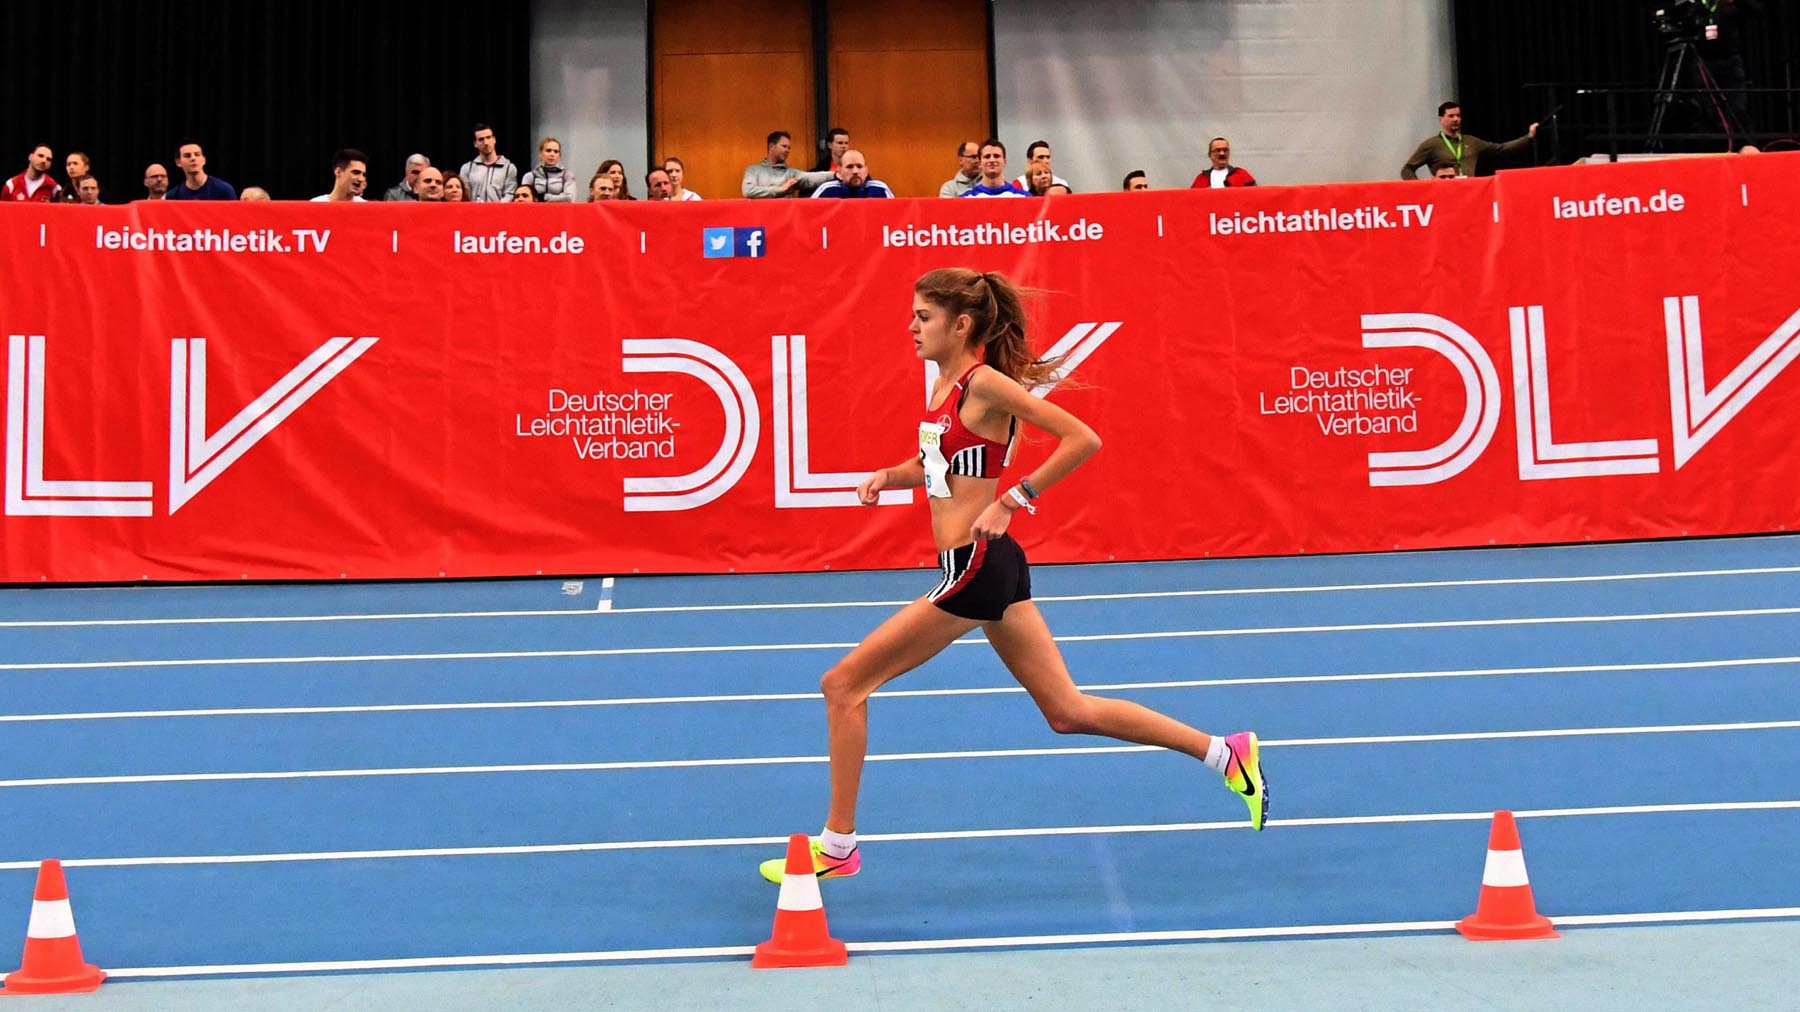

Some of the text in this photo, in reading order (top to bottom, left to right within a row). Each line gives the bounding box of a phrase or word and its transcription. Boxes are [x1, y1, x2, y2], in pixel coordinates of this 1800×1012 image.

[1553, 189, 1685, 219] laufen.de
[1209, 203, 1434, 235] leichtathletik.TV
[96, 225, 331, 253] leichtathletik.TV
[454, 231, 585, 254] laufen.de
[882, 218, 1104, 248] leichtathletik.de
[1290, 364, 1414, 390] Deutscher
[549, 389, 673, 412] Deutscher
[1260, 388, 1422, 415] Leichtathletik-
[1361, 295, 1800, 487] DLV
[516, 412, 681, 437] Leichtathletik-
[1316, 411, 1418, 436] Verband
[573, 434, 675, 460] Verband
